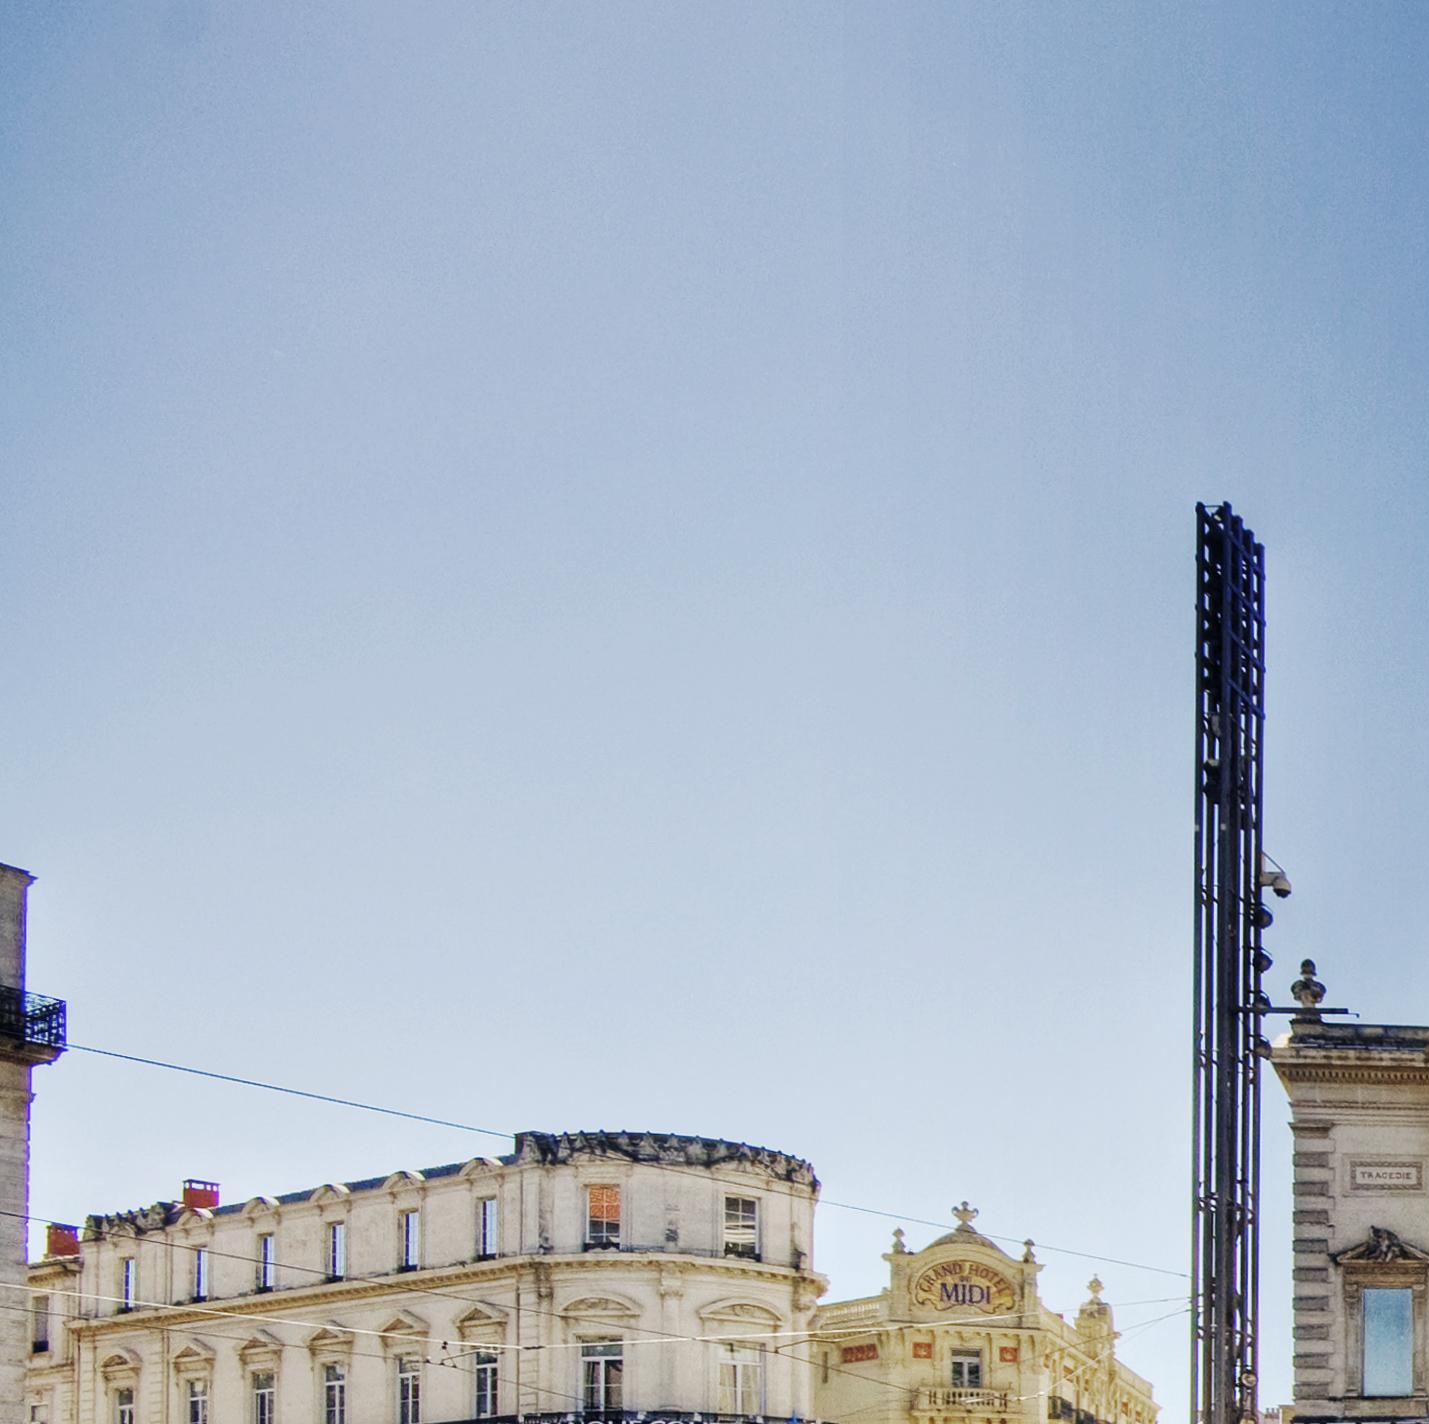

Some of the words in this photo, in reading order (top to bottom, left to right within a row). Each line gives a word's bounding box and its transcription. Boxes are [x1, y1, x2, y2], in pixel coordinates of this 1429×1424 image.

[1360, 1171, 1412, 1180] TRAGEDIE
[920, 1263, 962, 1292] GRAND
[968, 1263, 1011, 1294] HOTEL
[940, 1283, 991, 1304] MIDI
